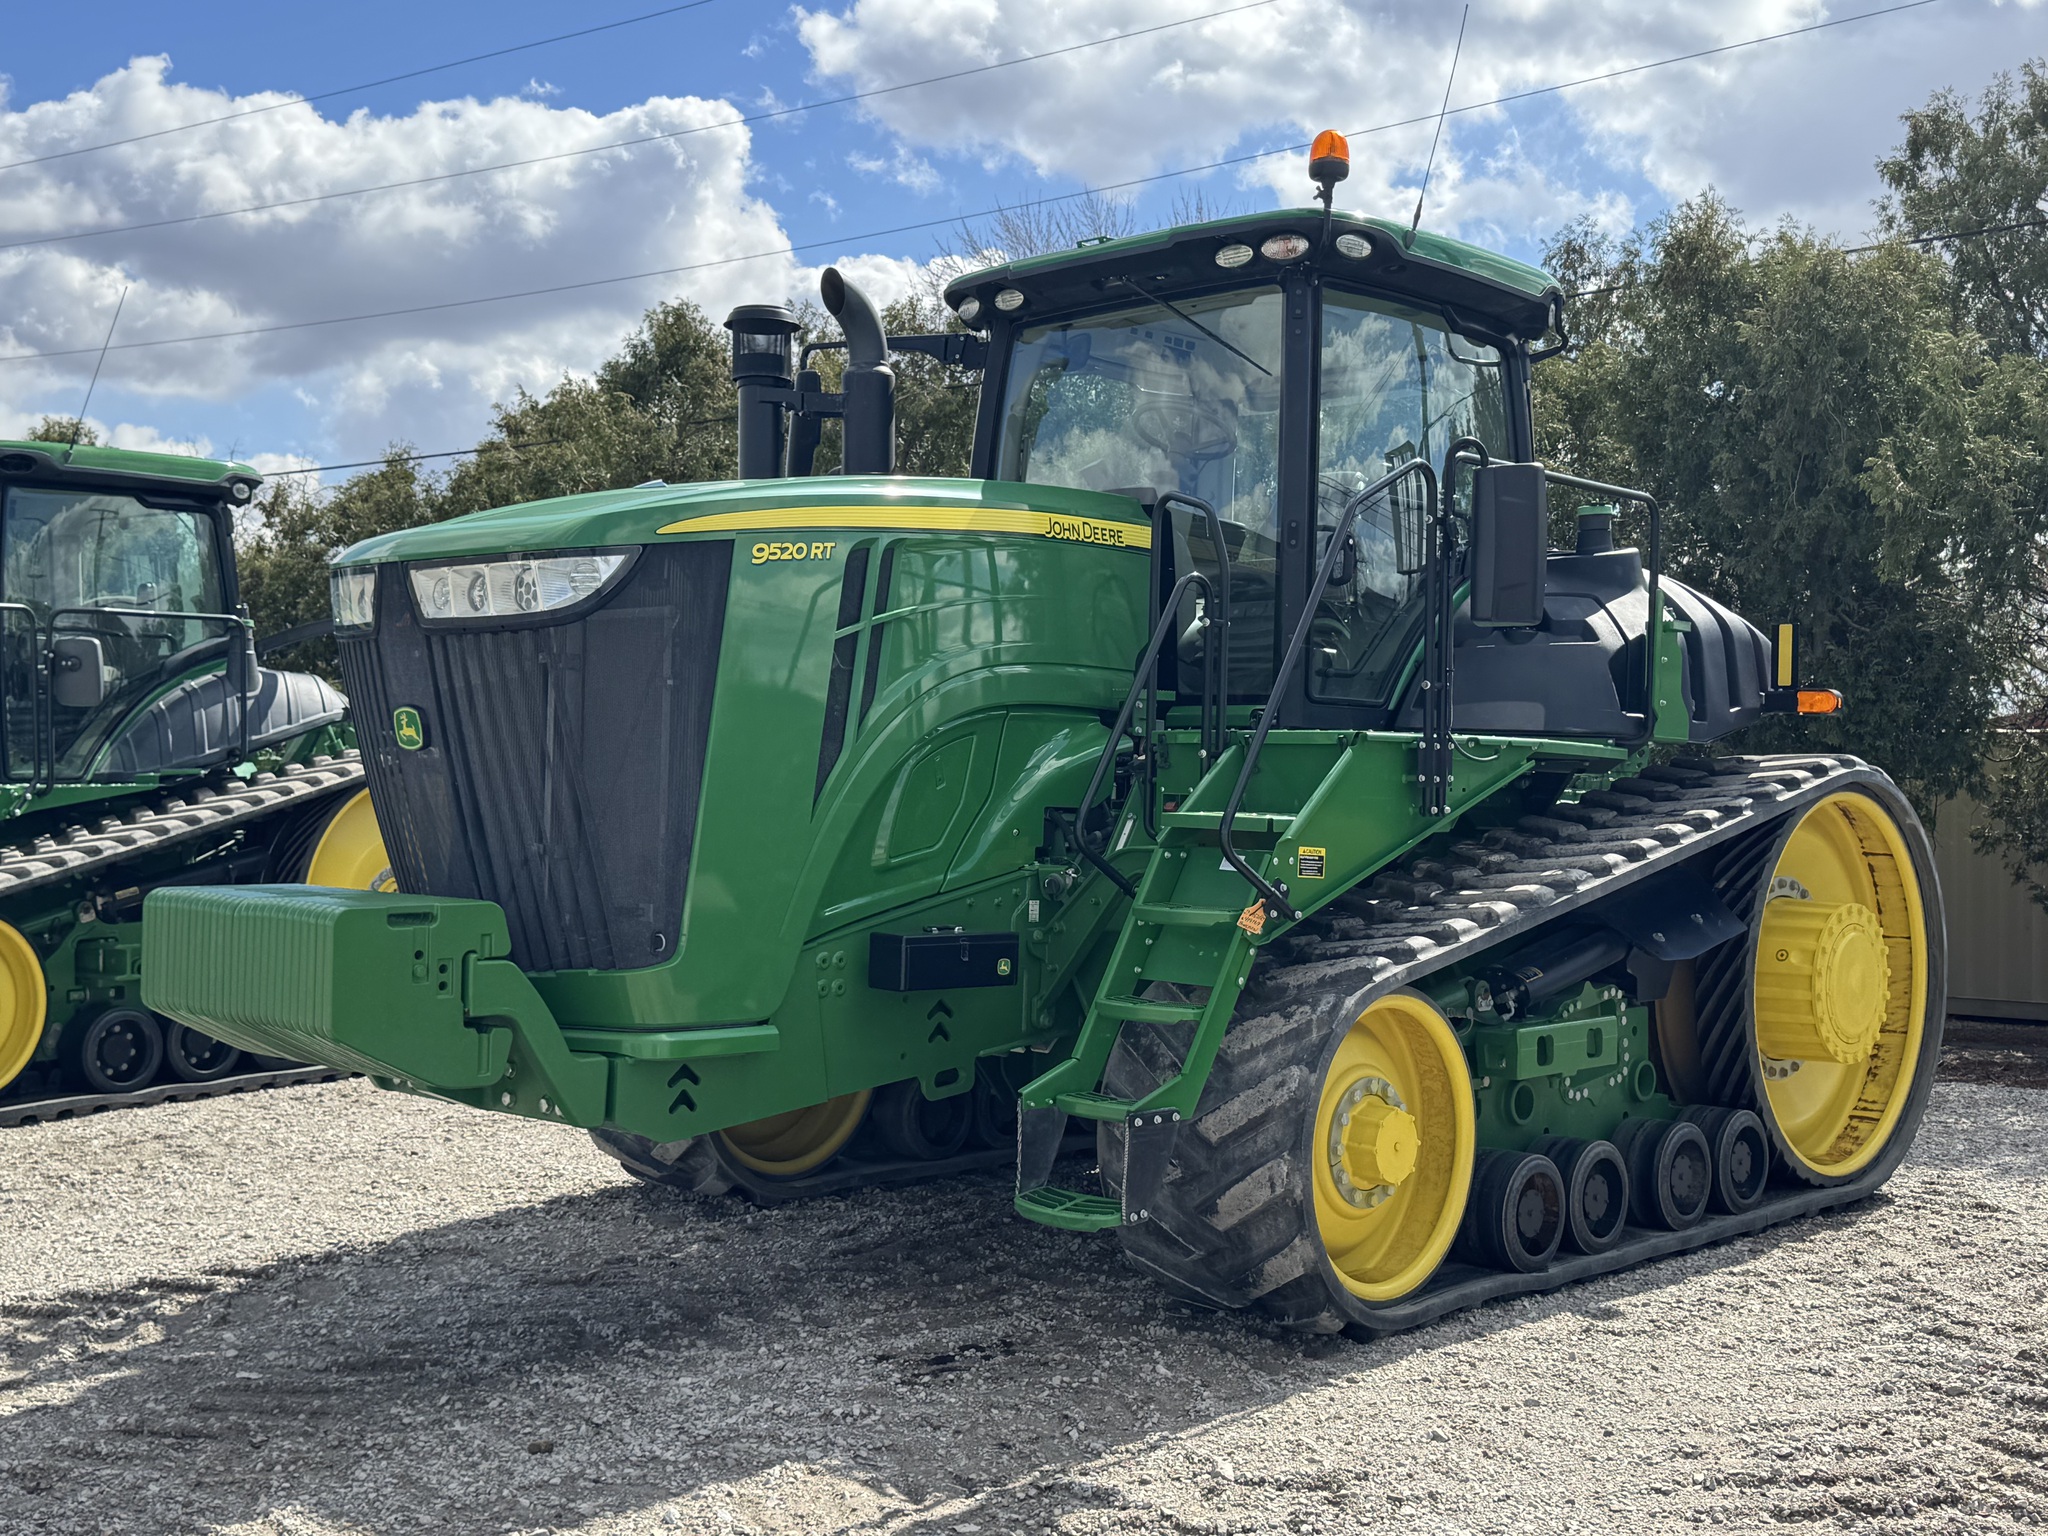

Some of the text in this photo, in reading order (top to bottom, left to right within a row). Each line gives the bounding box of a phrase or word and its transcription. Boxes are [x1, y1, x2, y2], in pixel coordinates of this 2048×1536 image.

[1045, 517, 1125, 545] JOHN DEERE
[751, 542, 836, 564] 9520 RT
